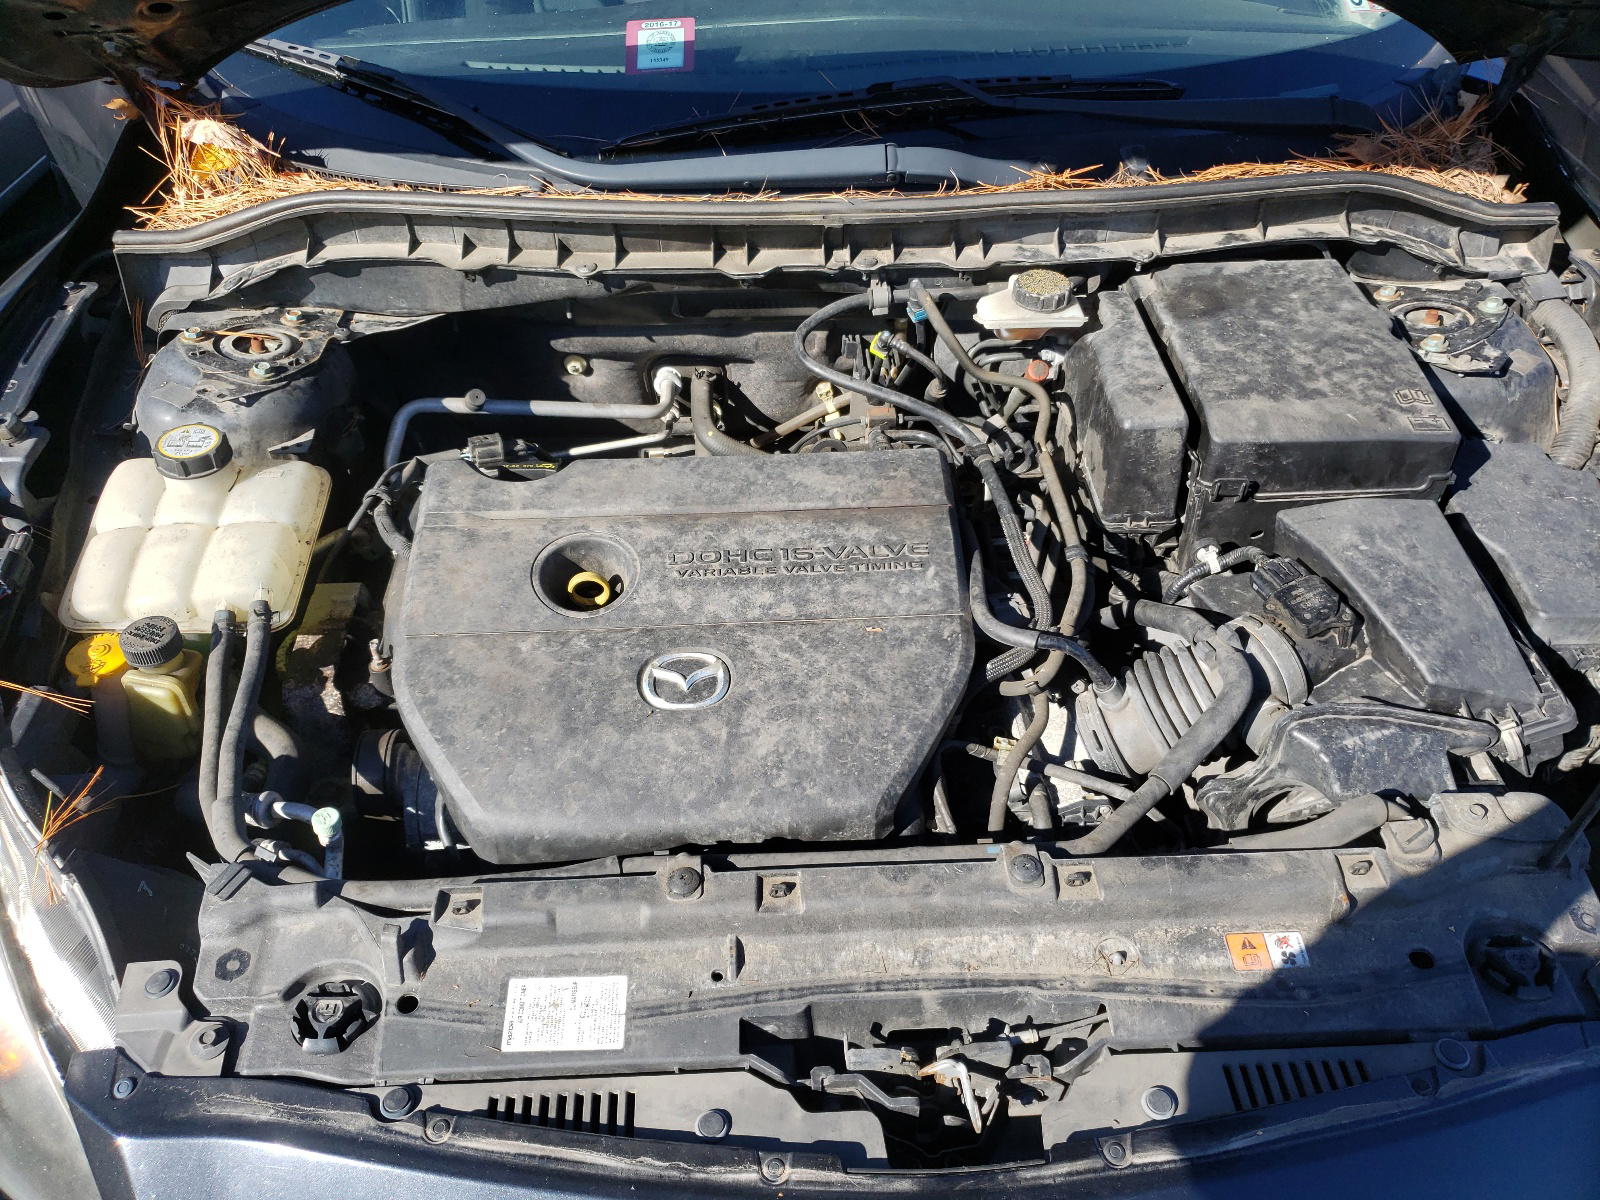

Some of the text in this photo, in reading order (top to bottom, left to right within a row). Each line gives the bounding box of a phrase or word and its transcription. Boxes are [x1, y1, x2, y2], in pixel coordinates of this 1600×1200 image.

[644, 20, 678, 28] 2016-17
[667, 547, 774, 566] DOHC
[675, 560, 924, 579] VARIABLE VALVE TIMING
